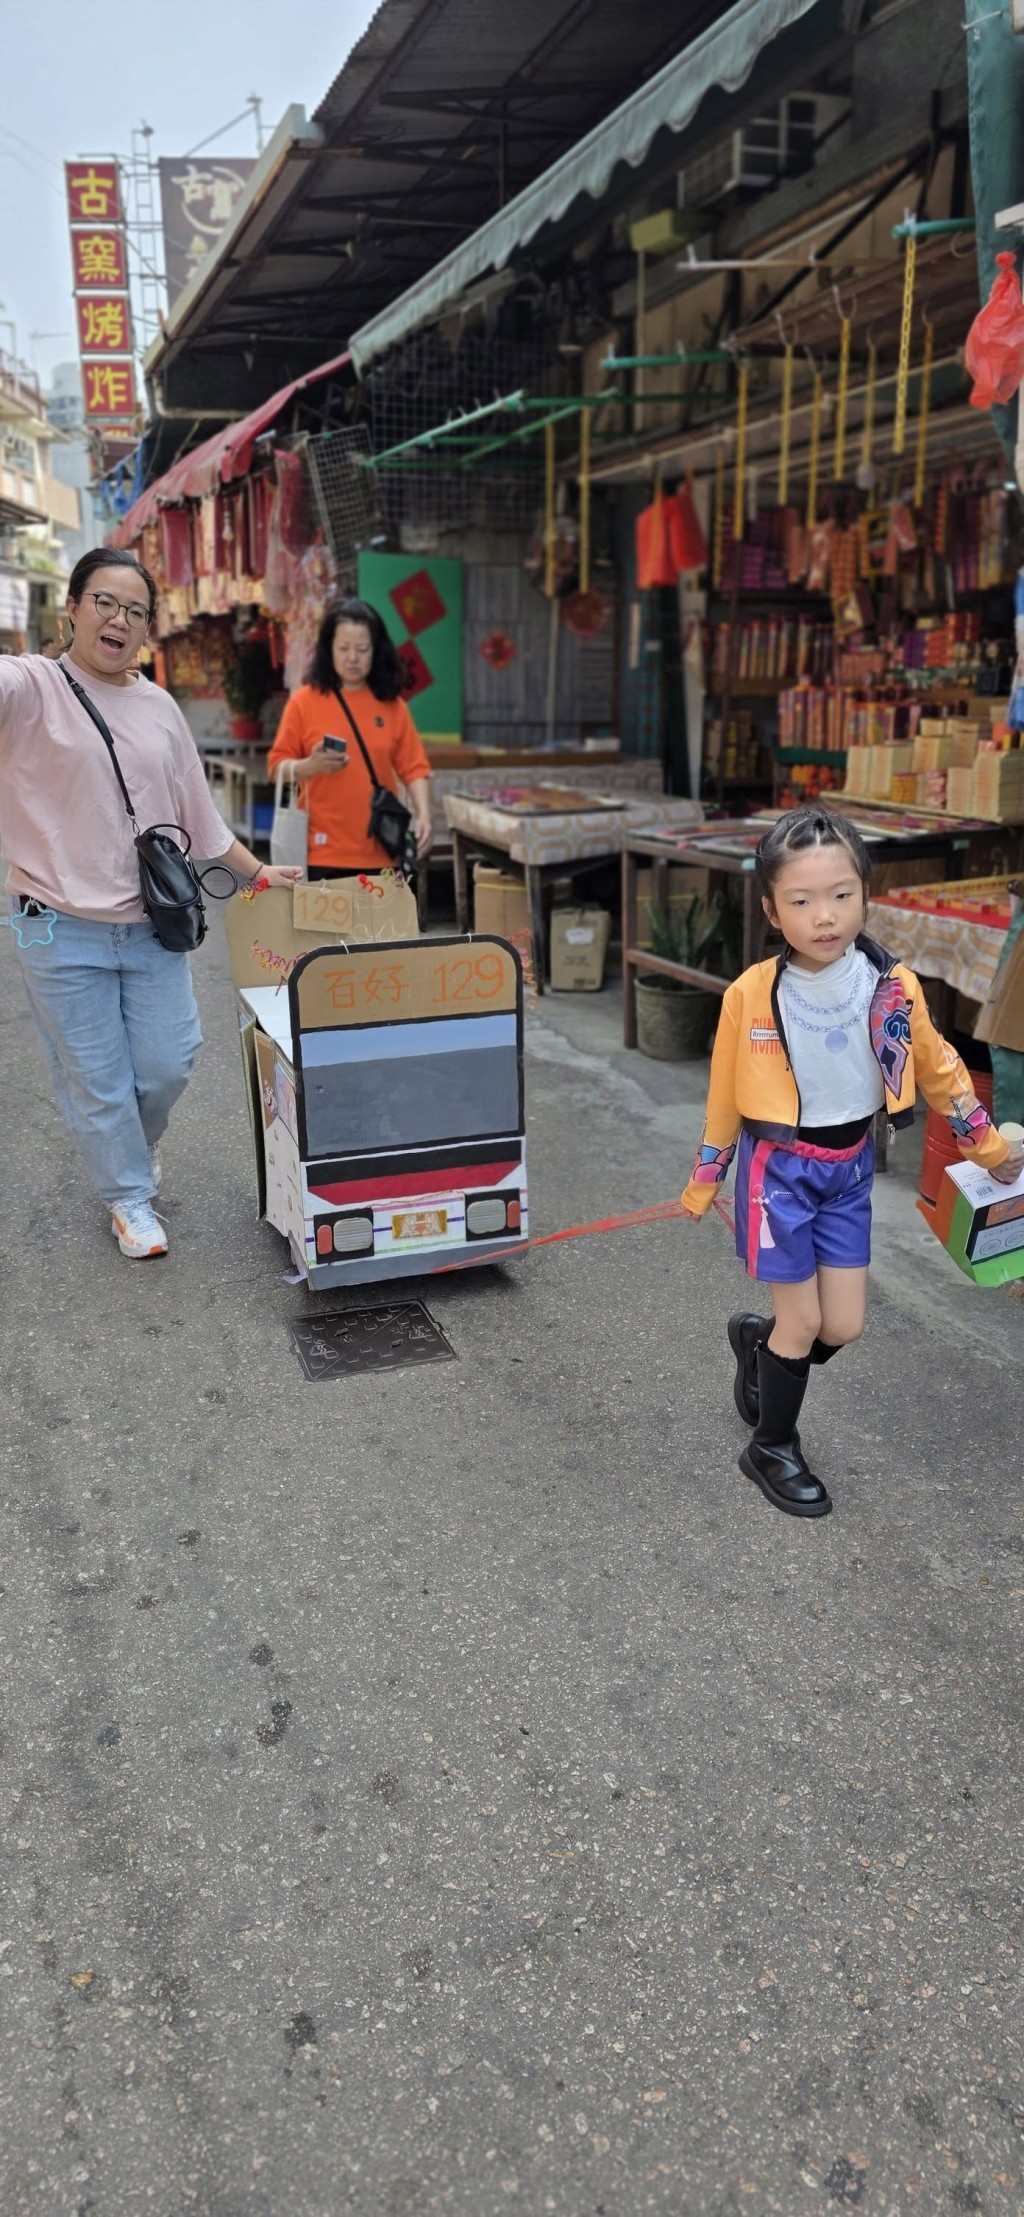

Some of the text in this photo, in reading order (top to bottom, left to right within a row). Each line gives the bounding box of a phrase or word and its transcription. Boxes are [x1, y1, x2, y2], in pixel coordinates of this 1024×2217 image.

[72, 168, 129, 437] 古窯烤炸
[297, 891, 350, 927] 129
[323, 954, 505, 1009] 百好 129
